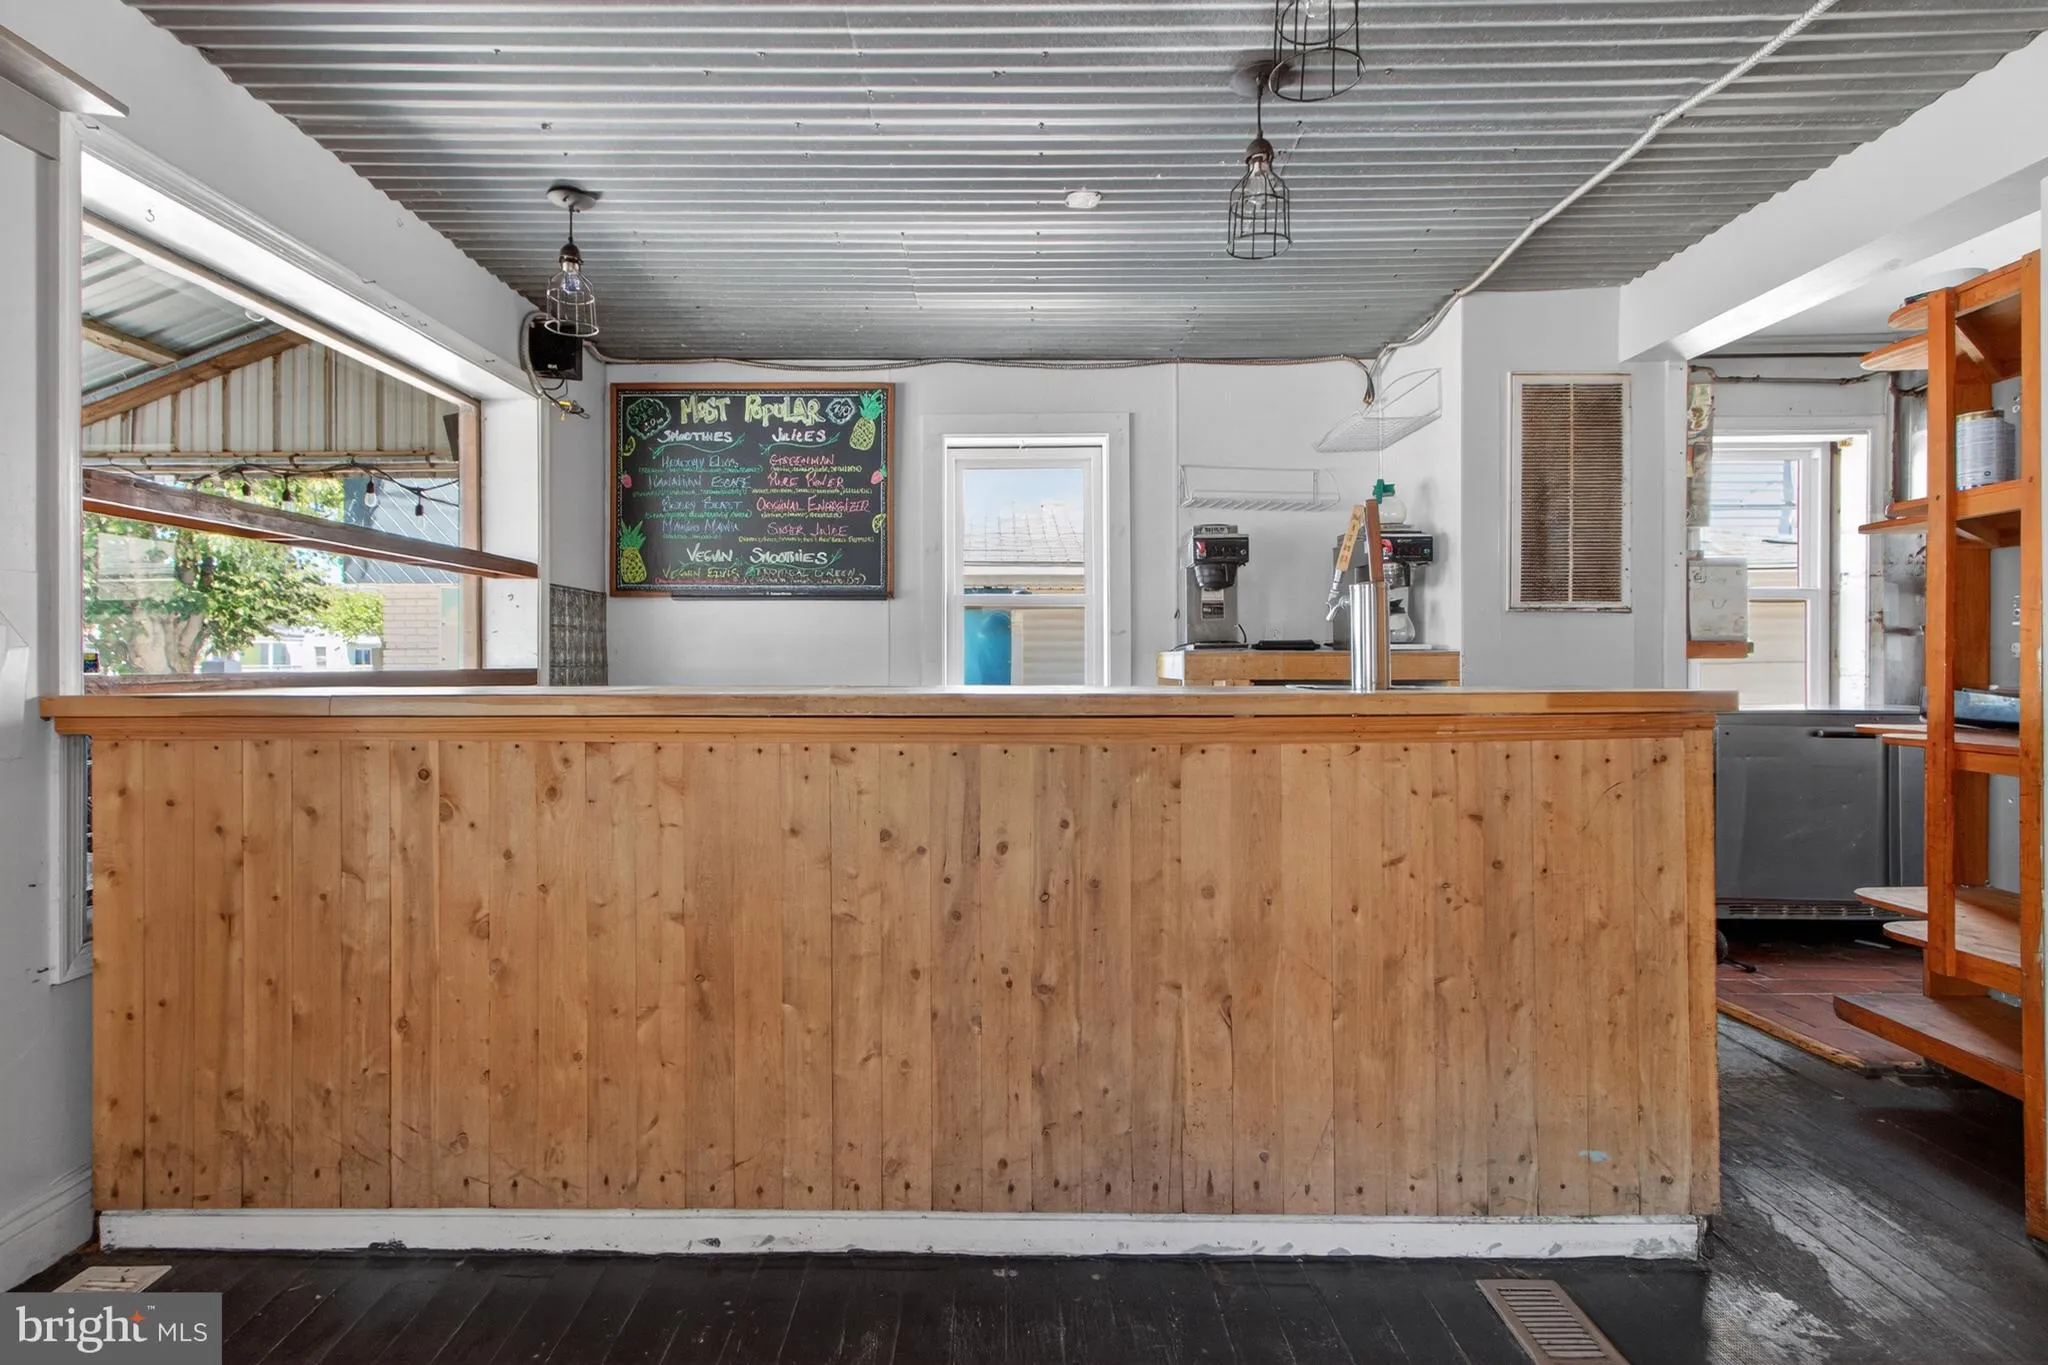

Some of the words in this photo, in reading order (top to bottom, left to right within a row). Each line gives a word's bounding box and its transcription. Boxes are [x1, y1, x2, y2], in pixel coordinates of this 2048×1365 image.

[657, 429, 733, 443] SMOOTHIES
[771, 427, 827, 442] JUICES
[686, 542, 733, 562] VEGAN
[749, 547, 828, 565] SMOOTHIES
